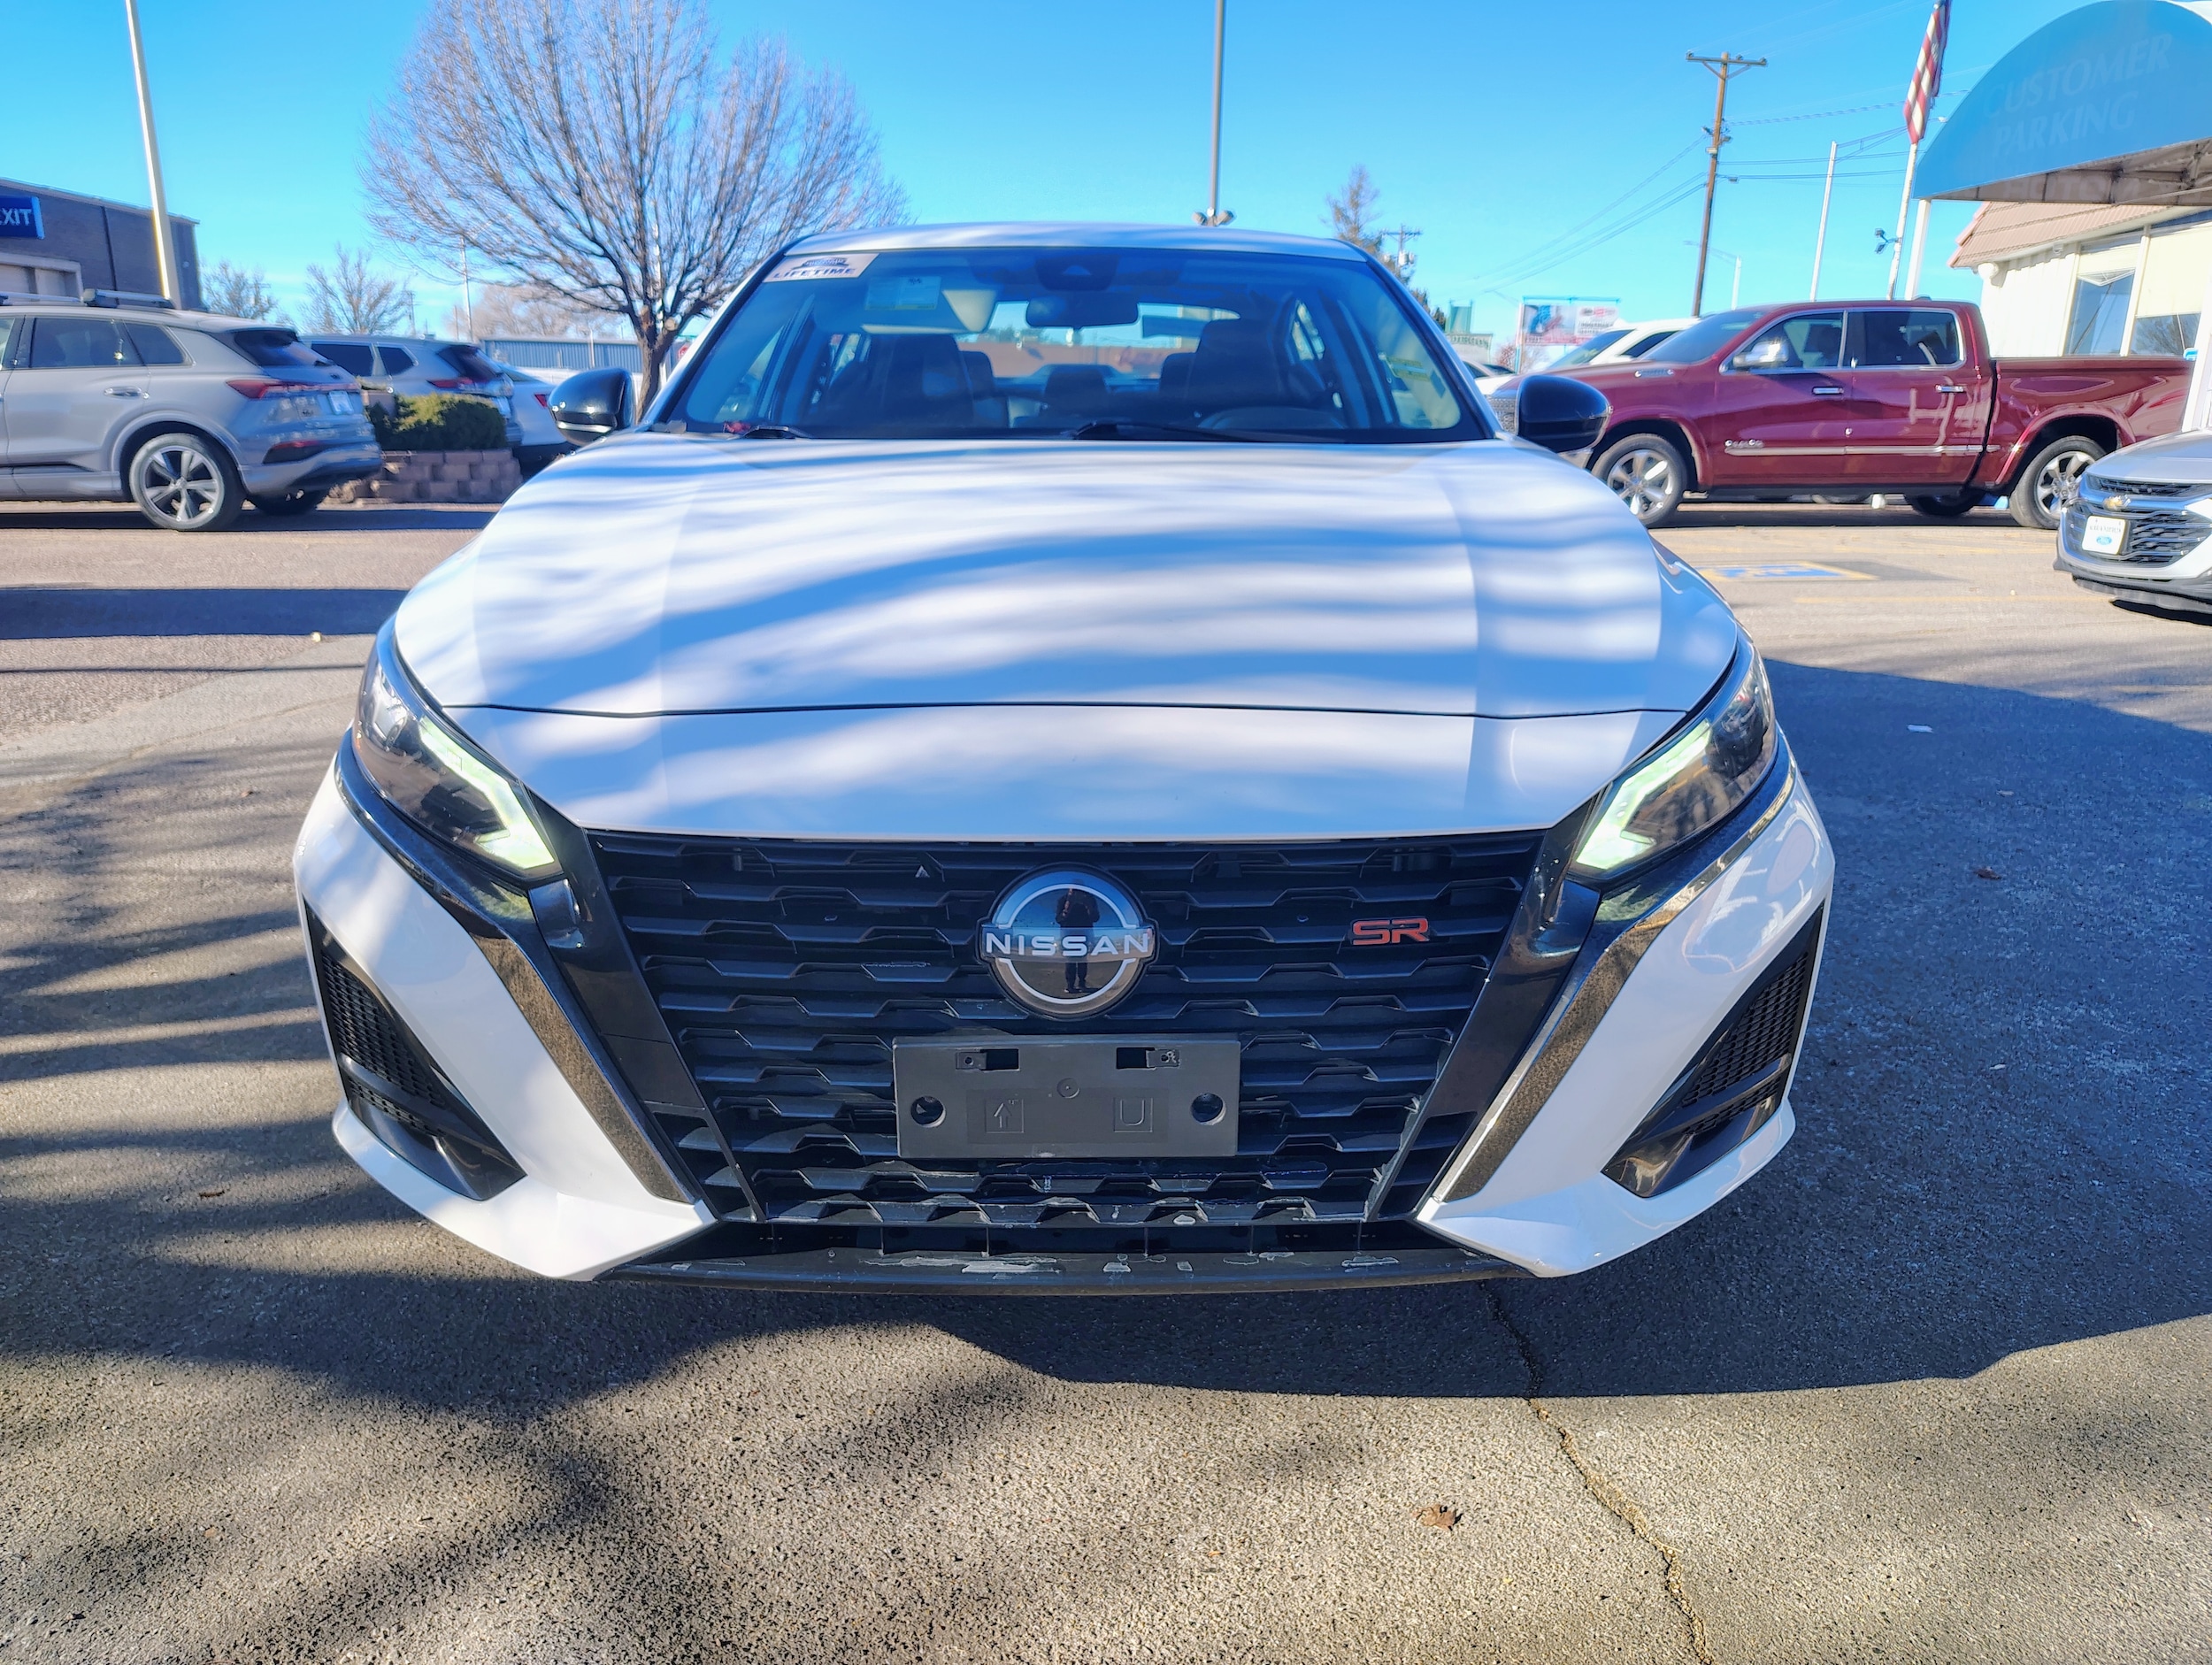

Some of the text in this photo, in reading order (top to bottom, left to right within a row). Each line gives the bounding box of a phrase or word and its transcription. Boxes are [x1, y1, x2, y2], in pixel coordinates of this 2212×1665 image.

[1984, 33, 2172, 118] CUSTOMER
[1993, 90, 2139, 157] PARKING
[0, 207, 32, 226] XIT
[773, 267, 856, 279] LIFETIME
[985, 932, 1149, 957] NISSAN
[1352, 917, 1430, 946] SR
